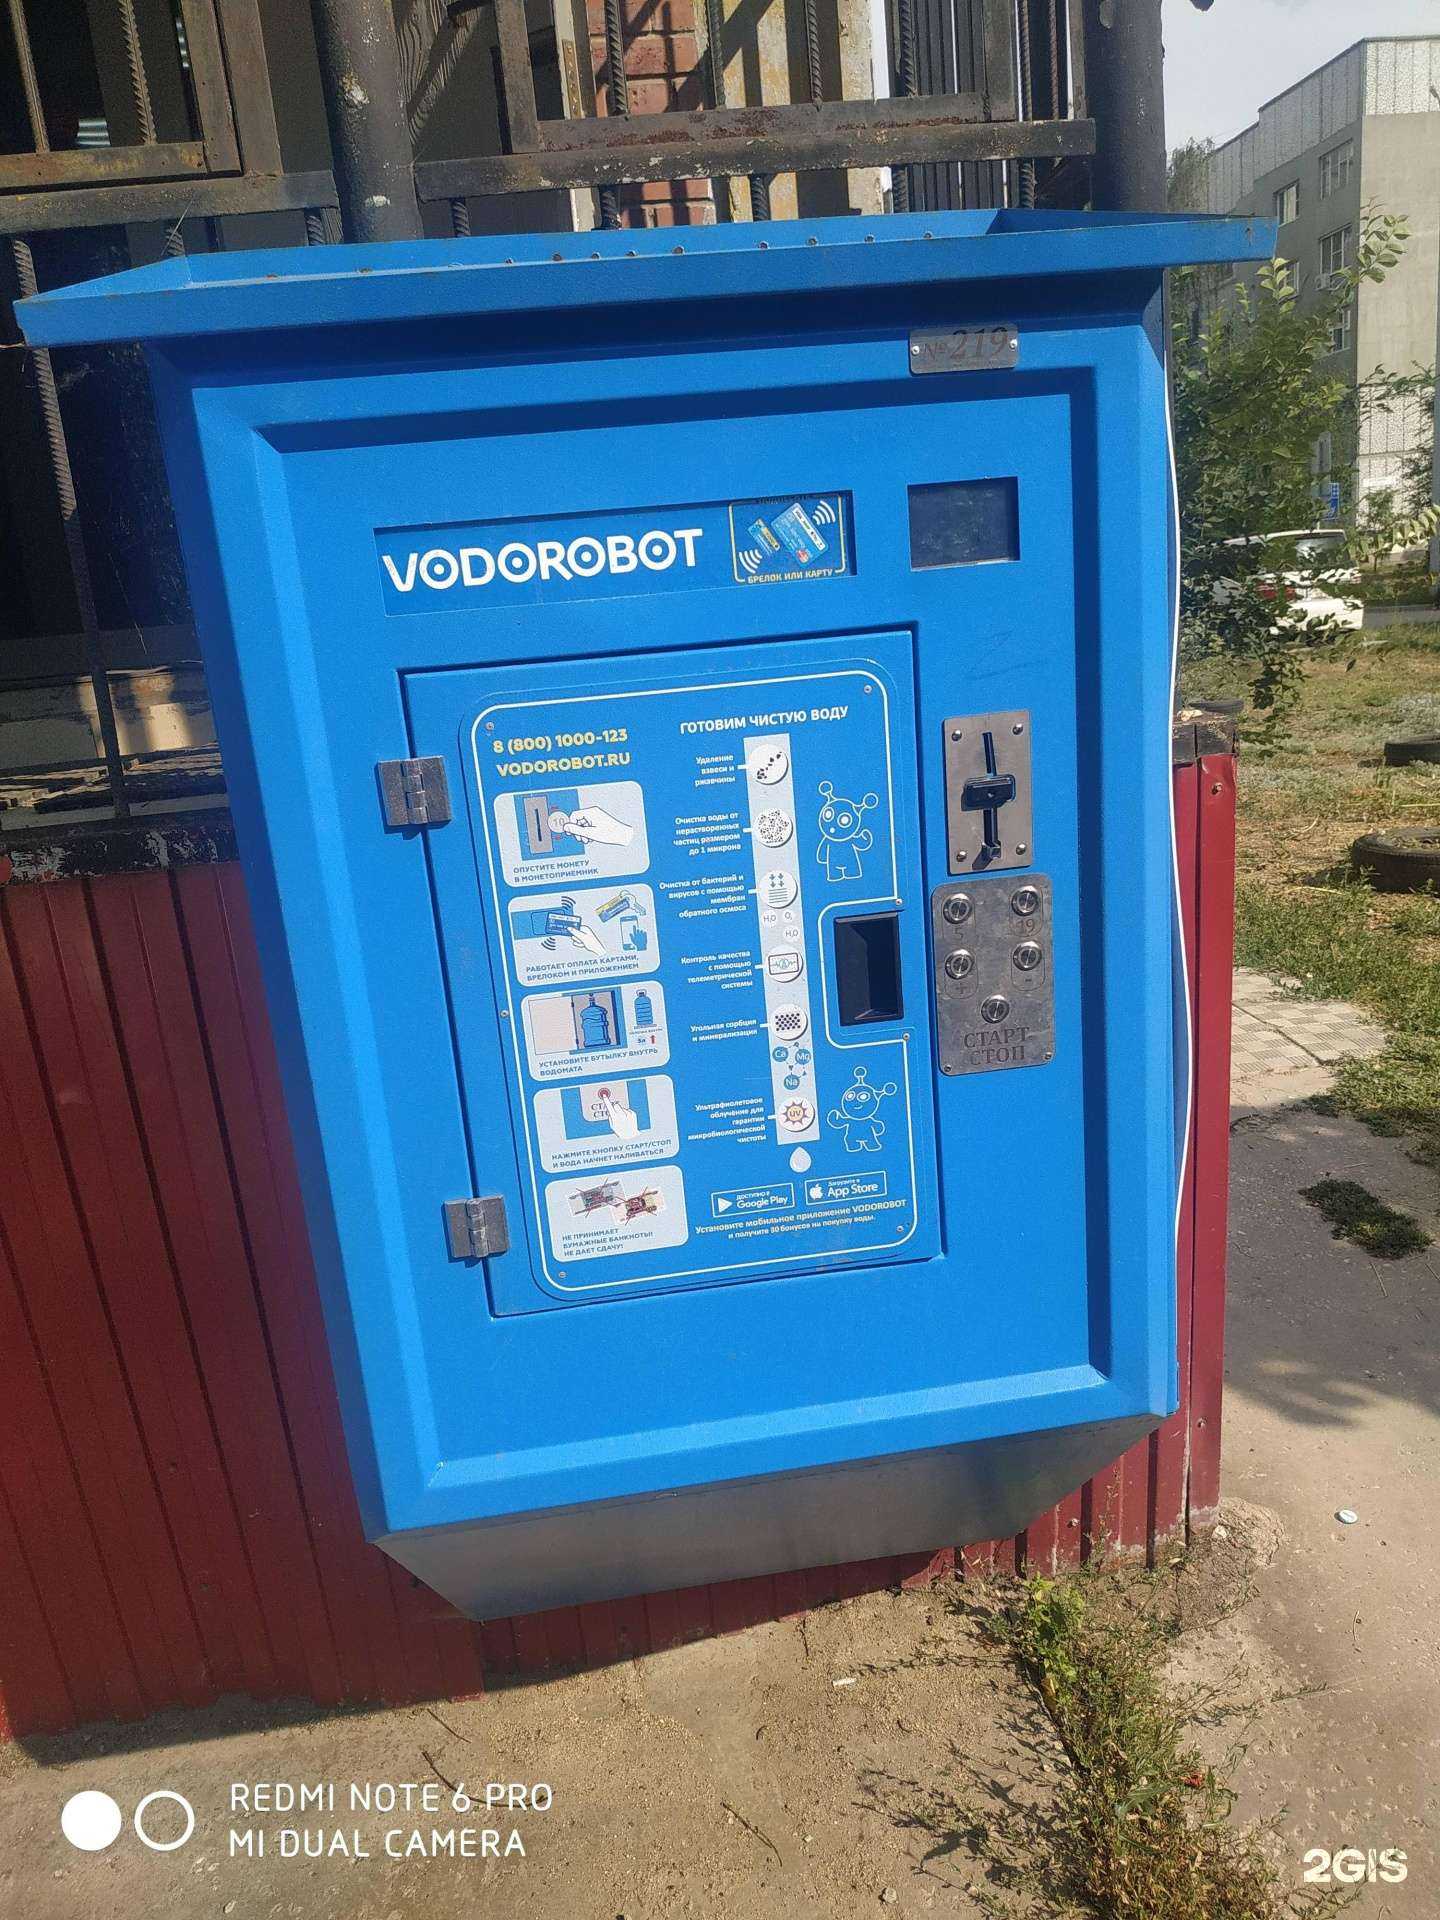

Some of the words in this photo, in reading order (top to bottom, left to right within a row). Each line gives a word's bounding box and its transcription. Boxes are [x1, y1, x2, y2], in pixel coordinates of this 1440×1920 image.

[381, 528, 704, 593] VODOROBOT
[748, 574, 782, 584] БРЕЛОК
[784, 572, 803, 580] ИЛИ
[806, 568, 833, 578] КАРТУ
[680, 716, 746, 735] ГОТОВИМ
[749, 710, 807, 727] ЧИСТУЮ
[810, 705, 849, 721] ВОДУ
[493, 740, 504, 753] 8
[508, 736, 551, 755] (800)
[555, 728, 628, 747] 1000-123
[496, 752, 631, 777] VODOROBOT.RU
[696, 754, 734, 765] Удаление
[675, 815, 706, 825] Очистка
[708, 814, 729, 823] воды
[676, 823, 740, 835] нерастворенных
[673, 837, 700, 847] частиц
[701, 834, 741, 844] размером
[689, 849, 700, 857] до
[707, 843, 741, 854] микрона
[513, 863, 556, 874] ОПУСТИТЕ
[557, 859, 590, 870] МОНЕТУ
[521, 868, 599, 883] МОНЕТОПРИЕМНИК
[659, 880, 690, 890] Очистка
[702, 874, 737, 885] бактерий
[668, 890, 699, 900] вирусов
[706, 885, 744, 896] помощью
[710, 894, 746, 904] мембран
[679, 907, 718, 919] обратного
[719, 905, 747, 914] осмоса
[681, 955, 717, 965] Контроль
[717, 950, 751, 960] качества
[526, 962, 566, 973] РАБОТАЕТ
[566, 959, 599, 969] ОПЛАТА
[527, 970, 570, 981] БРЕЛОКОМ
[578, 962, 640, 976] ПРИЛОЖЕНИЕМ
[713, 961, 752, 971] помощью
[687, 970, 753, 983] телеметрической
[721, 981, 753, 989] системы
[690, 1022, 724, 1032] Угольная
[725, 1019, 757, 1030] сорбция
[964, 1026, 1030, 1048] СТАРТ
[538, 1056, 590, 1068] УСТАНОВИТЕ
[590, 1051, 627, 1062] БУТЫЛКУ
[628, 1048, 658, 1057] ВНУТРЬ
[969, 1045, 1025, 1065] СТОП
[540, 1066, 583, 1076] ВОДОМАТА
[694, 1097, 763, 1112] Ультрафиолетовое
[710, 1109, 749, 1119] облучение
[750, 1106, 764, 1116] для
[732, 1116, 765, 1126] гарантии
[687, 1125, 766, 1141] микробиологической
[737, 1135, 767, 1143] чистоты
[551, 1149, 591, 1160] НАЖМИТЕ
[592, 1146, 624, 1155] КНОПКУ
[625, 1139, 672, 1151] СТАРТ/СТОП
[559, 1159, 582, 1168] ВОДА
[582, 1155, 613, 1165] НАЧНЕТ
[613, 1149, 665, 1160] НАЛИВАТЬСЯ
[827, 1187, 850, 1199] App
[850, 1183, 879, 1194] Store
[736, 1198, 769, 1209] Google
[770, 1195, 788, 1206] Play
[695, 1222, 744, 1235] Установите
[745, 1215, 795, 1227] мобильное
[796, 1208, 851, 1222] приложение
[852, 1199, 906, 1214] VODOROBOT
[573, 1228, 619, 1239] ПРИНИМАЕТ
[734, 1228, 769, 1239] получите
[780, 1222, 811, 1233] бонусов
[822, 1217, 853, 1228] покупку
[563, 1238, 607, 1249] БУМАЖНЫЕ
[575, 1247, 596, 1256] ДАЕТ
